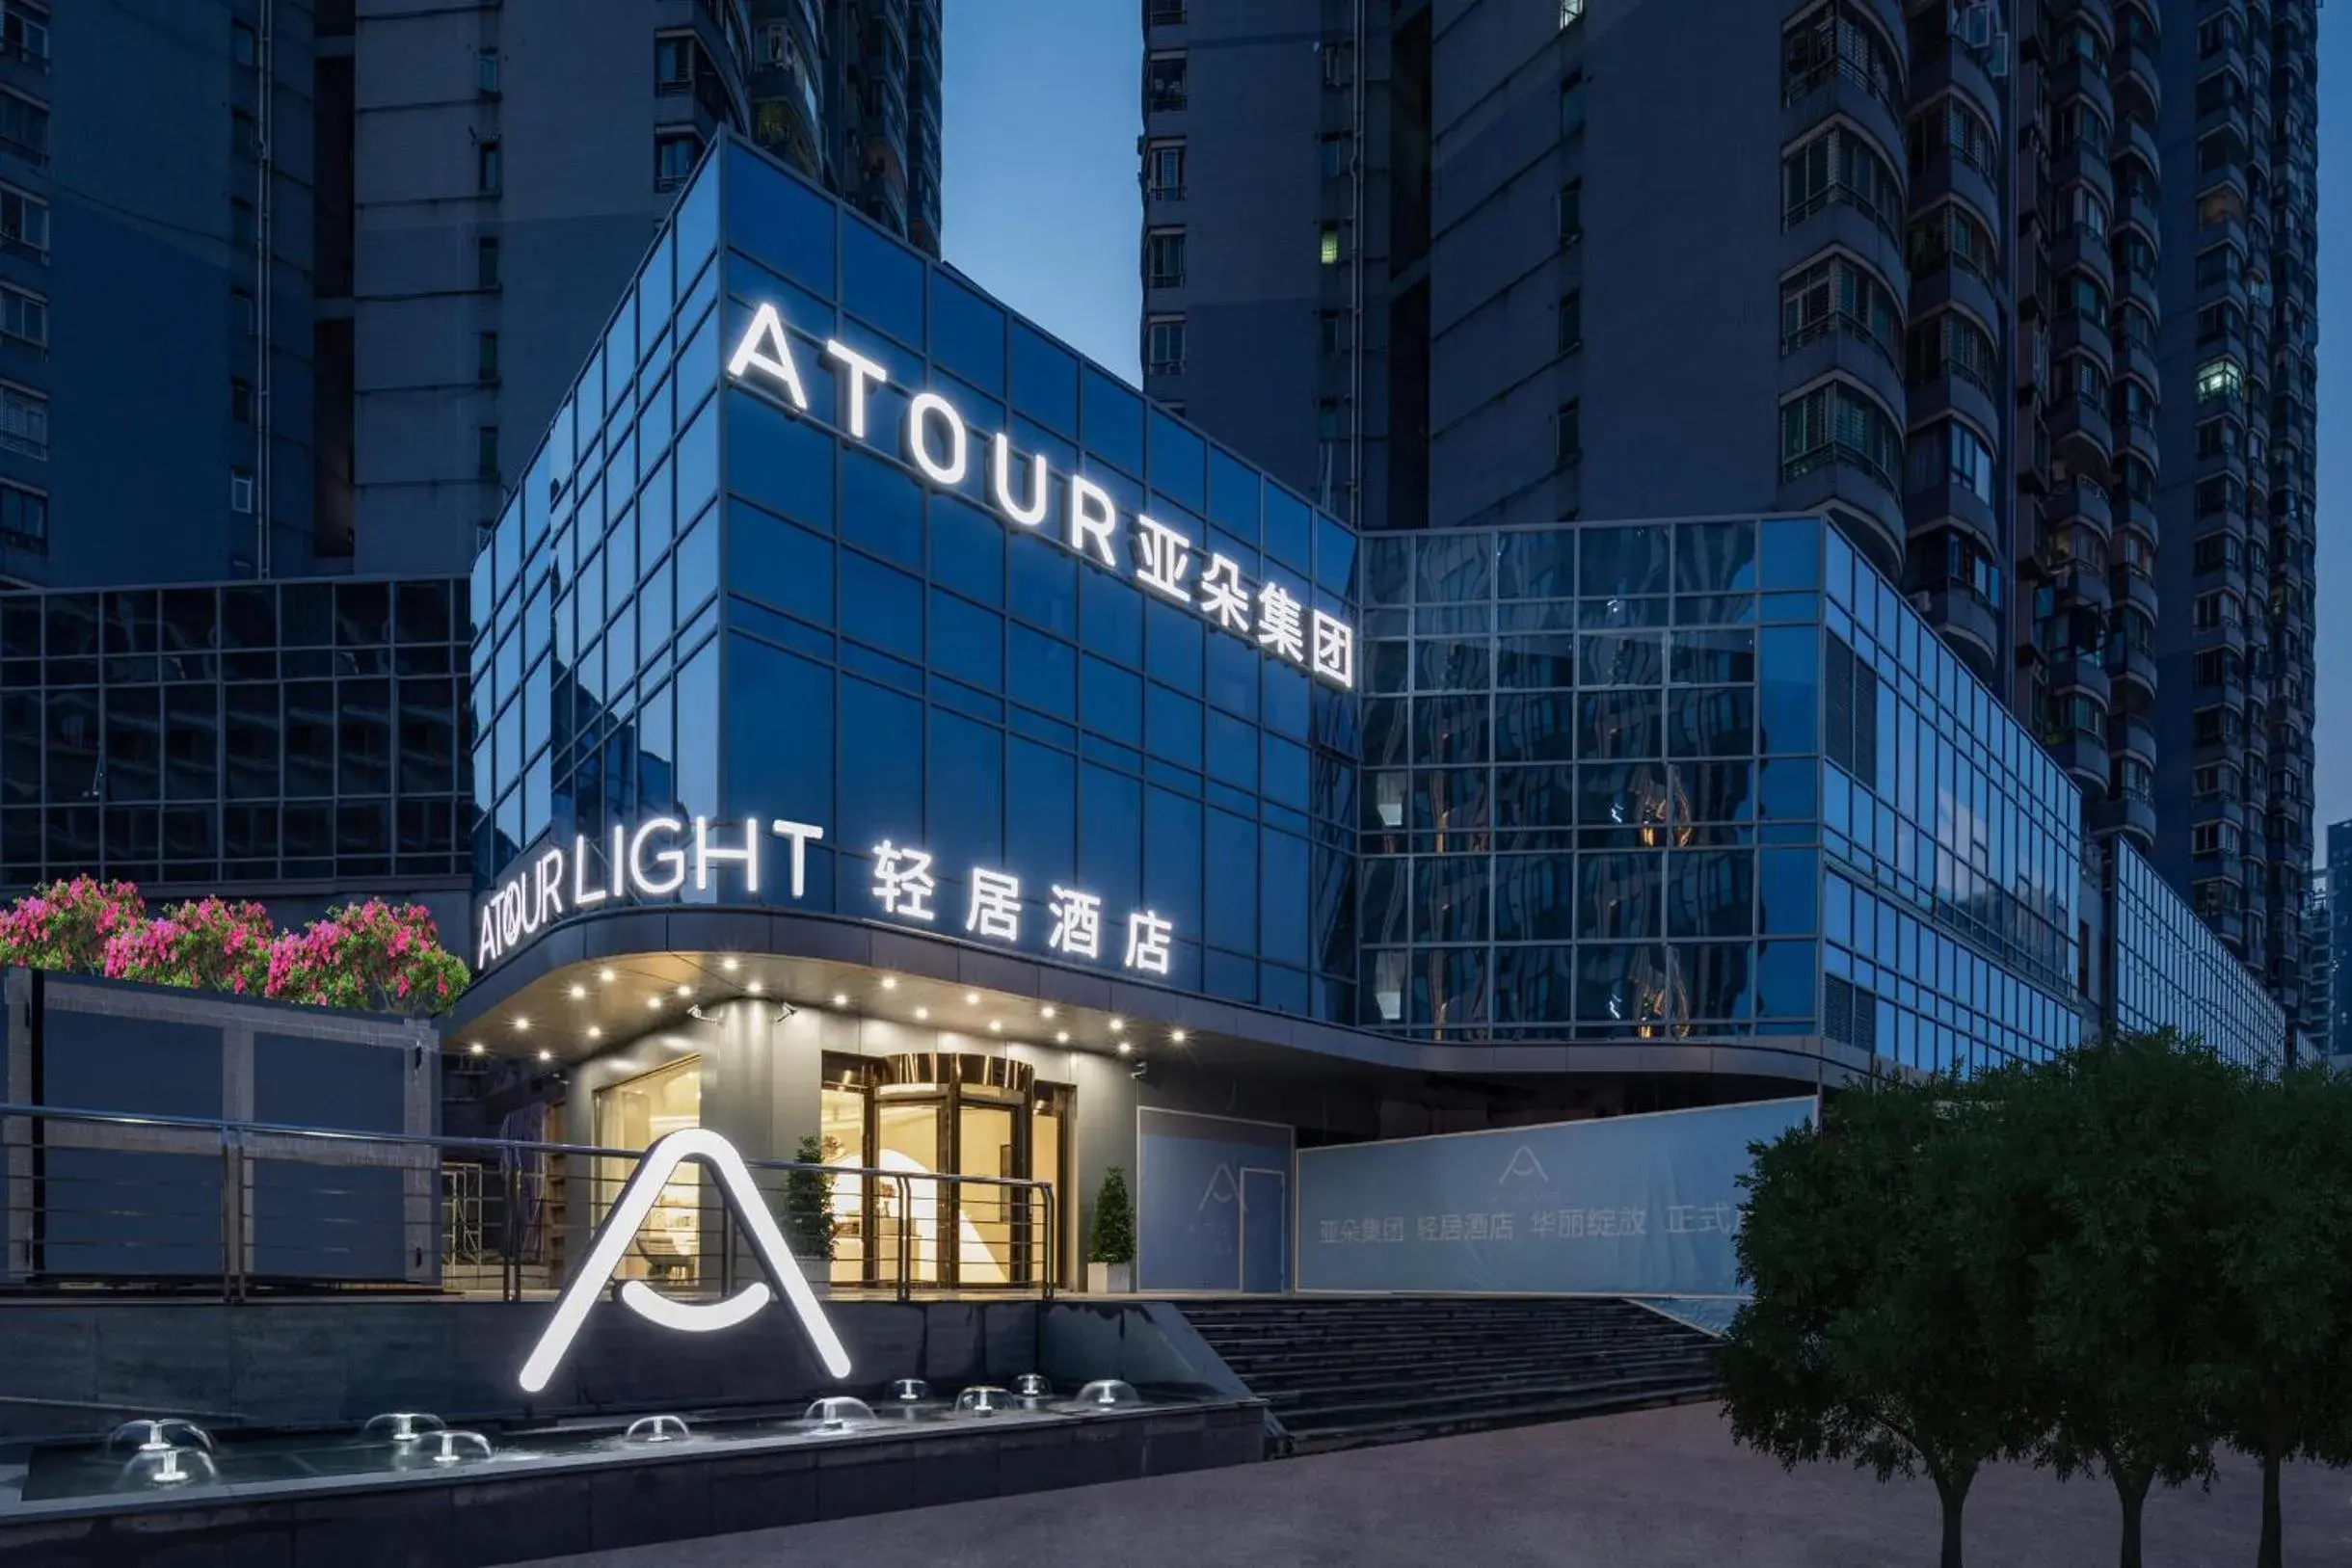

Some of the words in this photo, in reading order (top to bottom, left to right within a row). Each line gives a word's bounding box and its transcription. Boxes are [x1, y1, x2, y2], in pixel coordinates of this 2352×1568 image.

[728, 302, 1116, 567] ATOUR
[1136, 513, 1352, 688] 亚朵集团
[477, 848, 565, 970] ATOUR
[574, 815, 825, 906] LIGHT
[872, 837, 1173, 975] 轻居酒店
[1319, 1215, 1406, 1245] 亚朵集团
[1416, 1210, 1515, 1244] 轻居酒店
[1530, 1203, 1646, 1239] 华丽绽放
[1666, 1203, 1741, 1236] 正式
